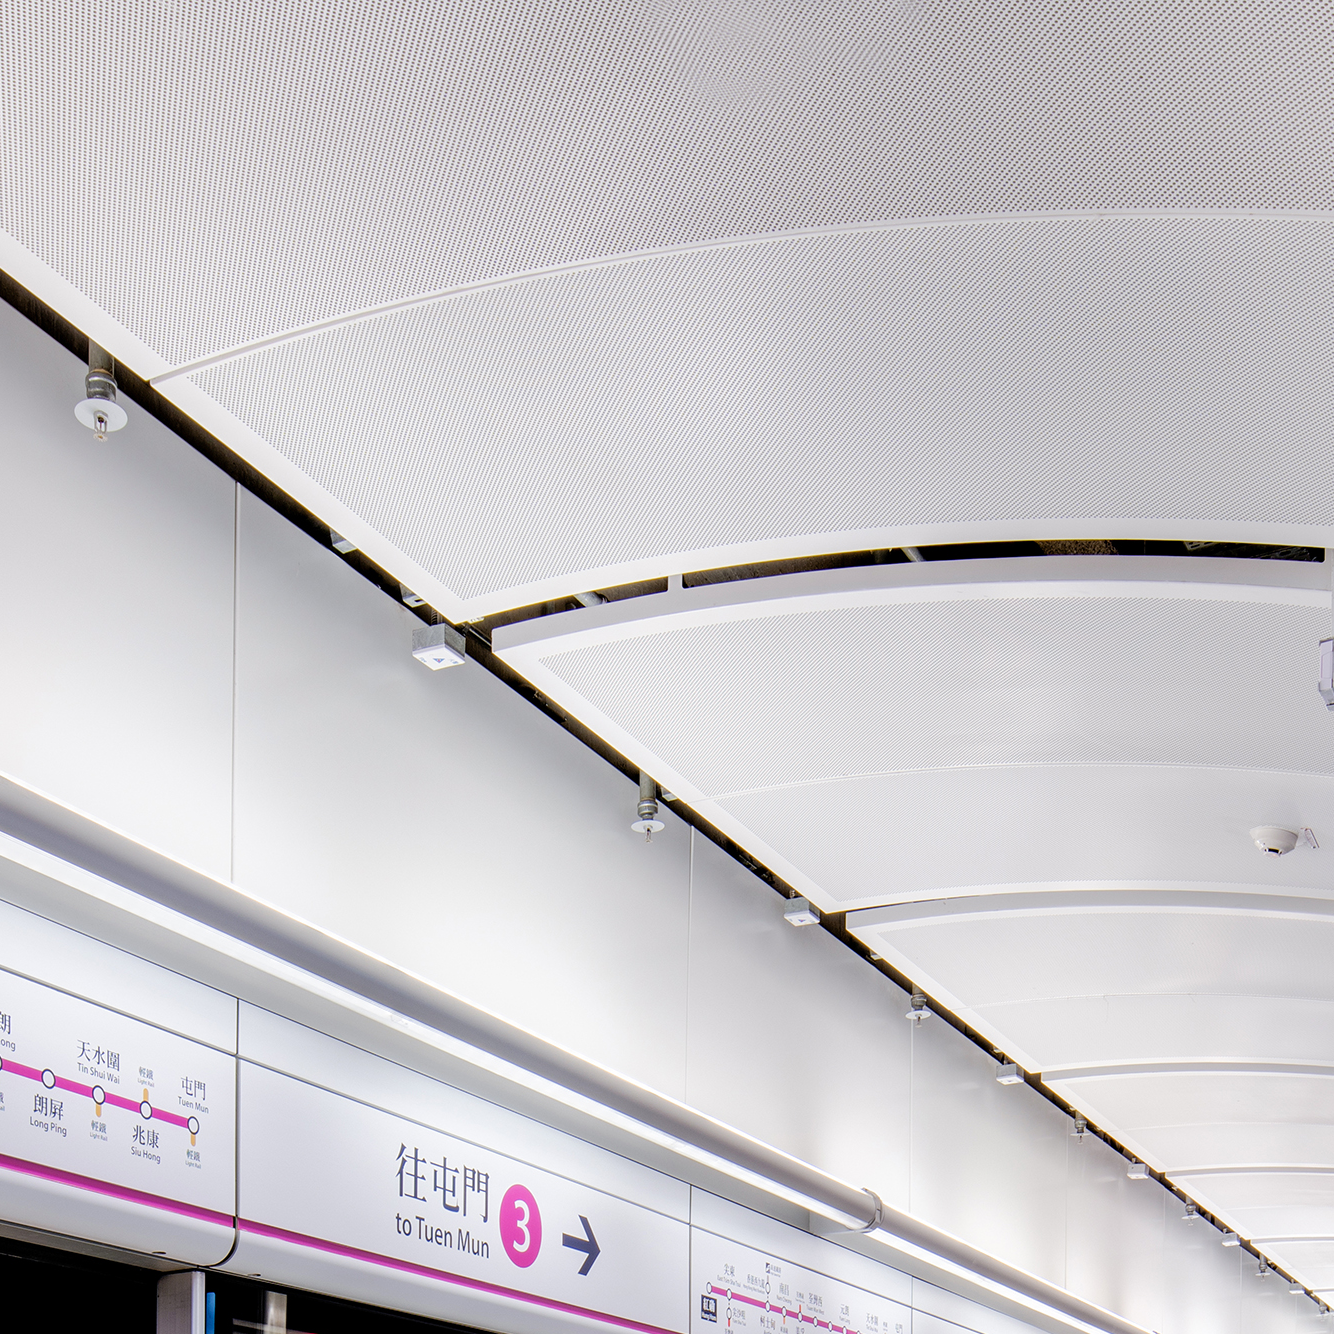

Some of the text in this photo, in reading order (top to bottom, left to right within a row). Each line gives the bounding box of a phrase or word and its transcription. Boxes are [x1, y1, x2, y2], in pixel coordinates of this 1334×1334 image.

[77, 1039, 120, 1072] 天水圍
[77, 1062, 120, 1084] Tin Shui Wai
[180, 1076, 206, 1101] 屯門
[178, 1096, 209, 1114] Tuen Mun
[30, 1116, 67, 1137] Long Ping
[132, 1125, 159, 1149] 兆康
[131, 1146, 161, 1165] Siu Hong
[396, 1143, 490, 1223] 往屯門
[396, 1213, 489, 1259] to Tuen Mun
[513, 1199, 531, 1253] 3
